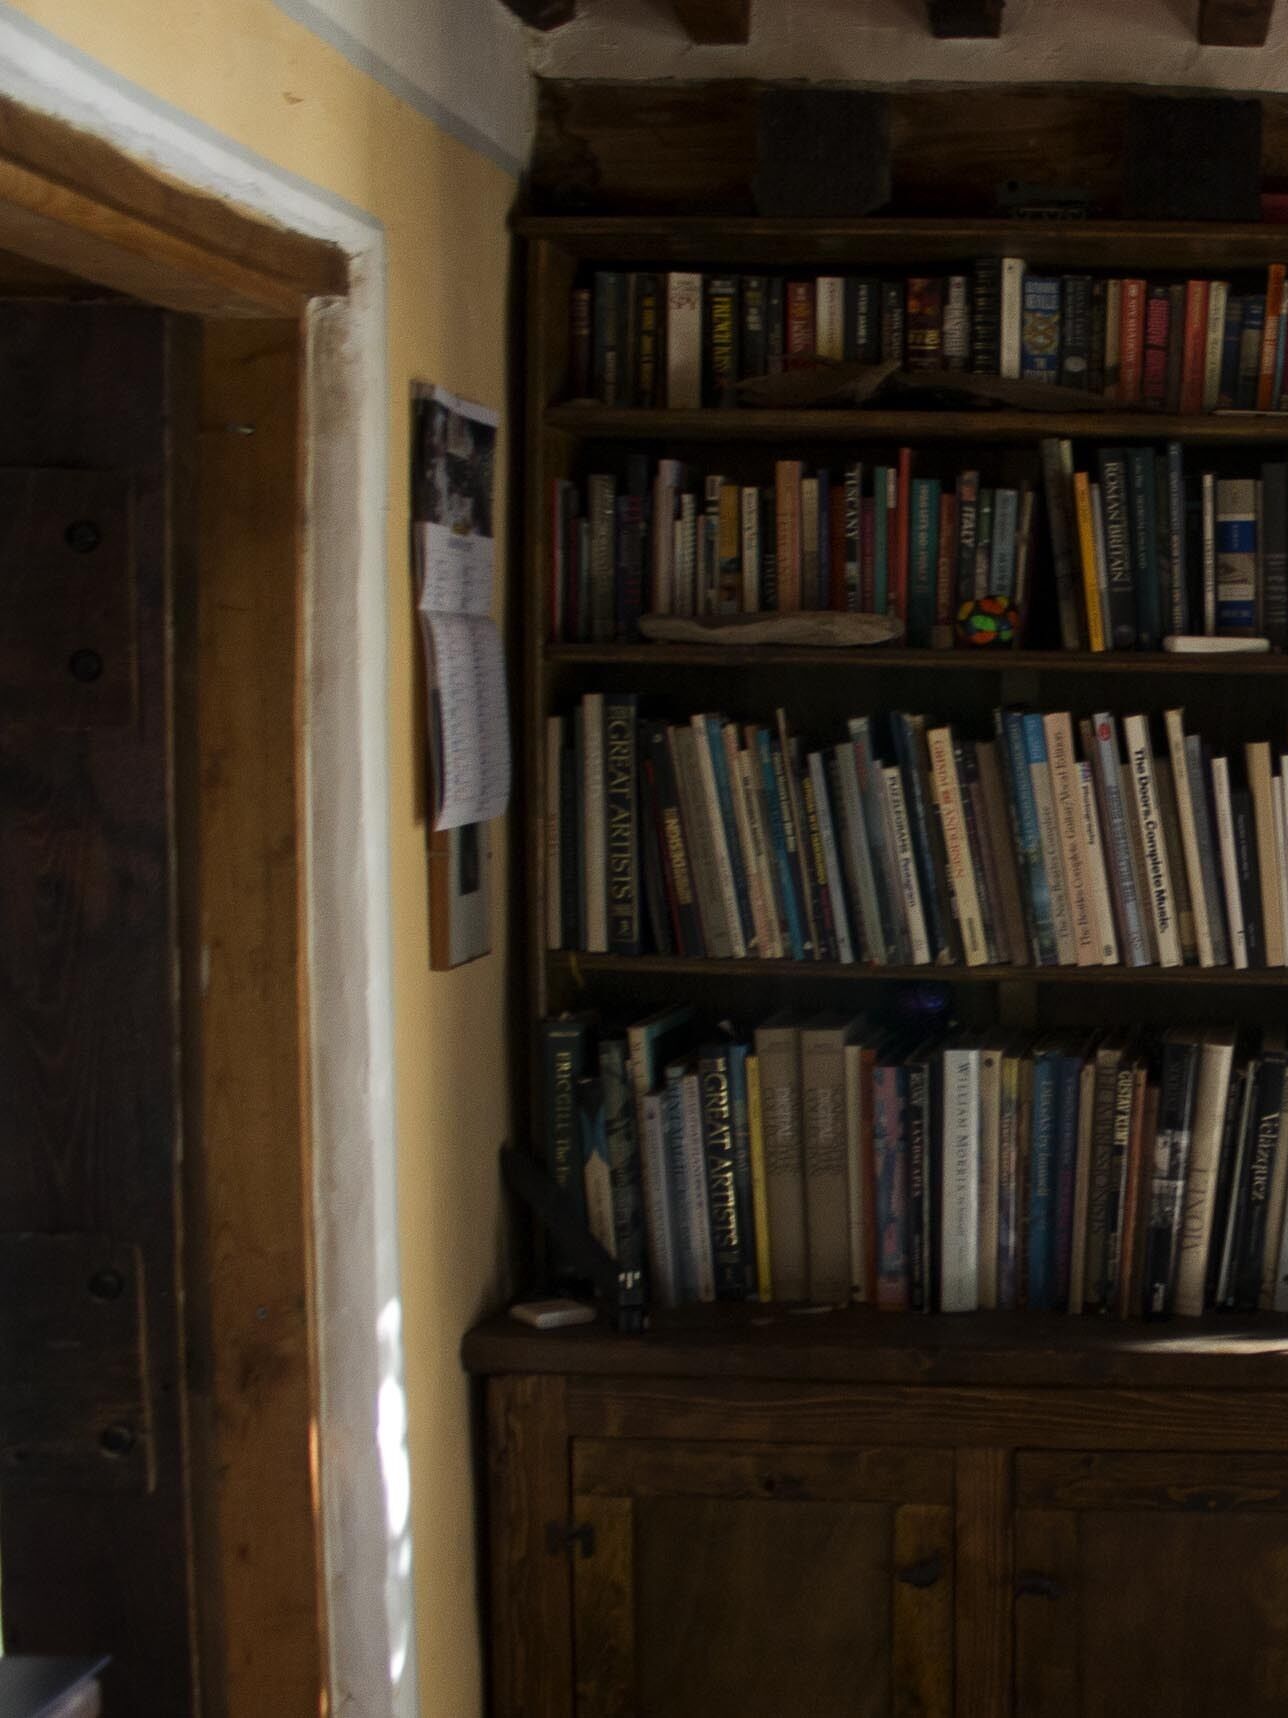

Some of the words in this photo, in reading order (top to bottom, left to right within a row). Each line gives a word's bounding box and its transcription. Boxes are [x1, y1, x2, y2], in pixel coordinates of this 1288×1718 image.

[844, 471, 860, 540] TUSCANY
[1104, 463, 1121, 519] ROMAN
[961, 506, 976, 547] ITALY
[1106, 524, 1124, 582] BRITAIN
[607, 720, 633, 799] GREAT
[1133, 750, 1147, 774] The
[933, 740, 950, 787] GRIMM
[942, 808, 966, 880] ANDERSEN
[1138, 777, 1152, 819] Doors.
[608, 804, 635, 900] ARTISTS
[1144, 821, 1165, 888] Complete
[1156, 890, 1173, 934] Music.
[556, 1051, 573, 1091] ERIC
[955, 1061, 972, 1128] WILLIAM
[1116, 1070, 1132, 1110] GUSTAV
[556, 1094, 572, 1129] GILL
[702, 1072, 731, 1149] GREAT
[1113, 1111, 1130, 1146] KLIMT
[955, 1135, 971, 1191] MORRIS
[708, 1155, 738, 1245] ARTISTS
